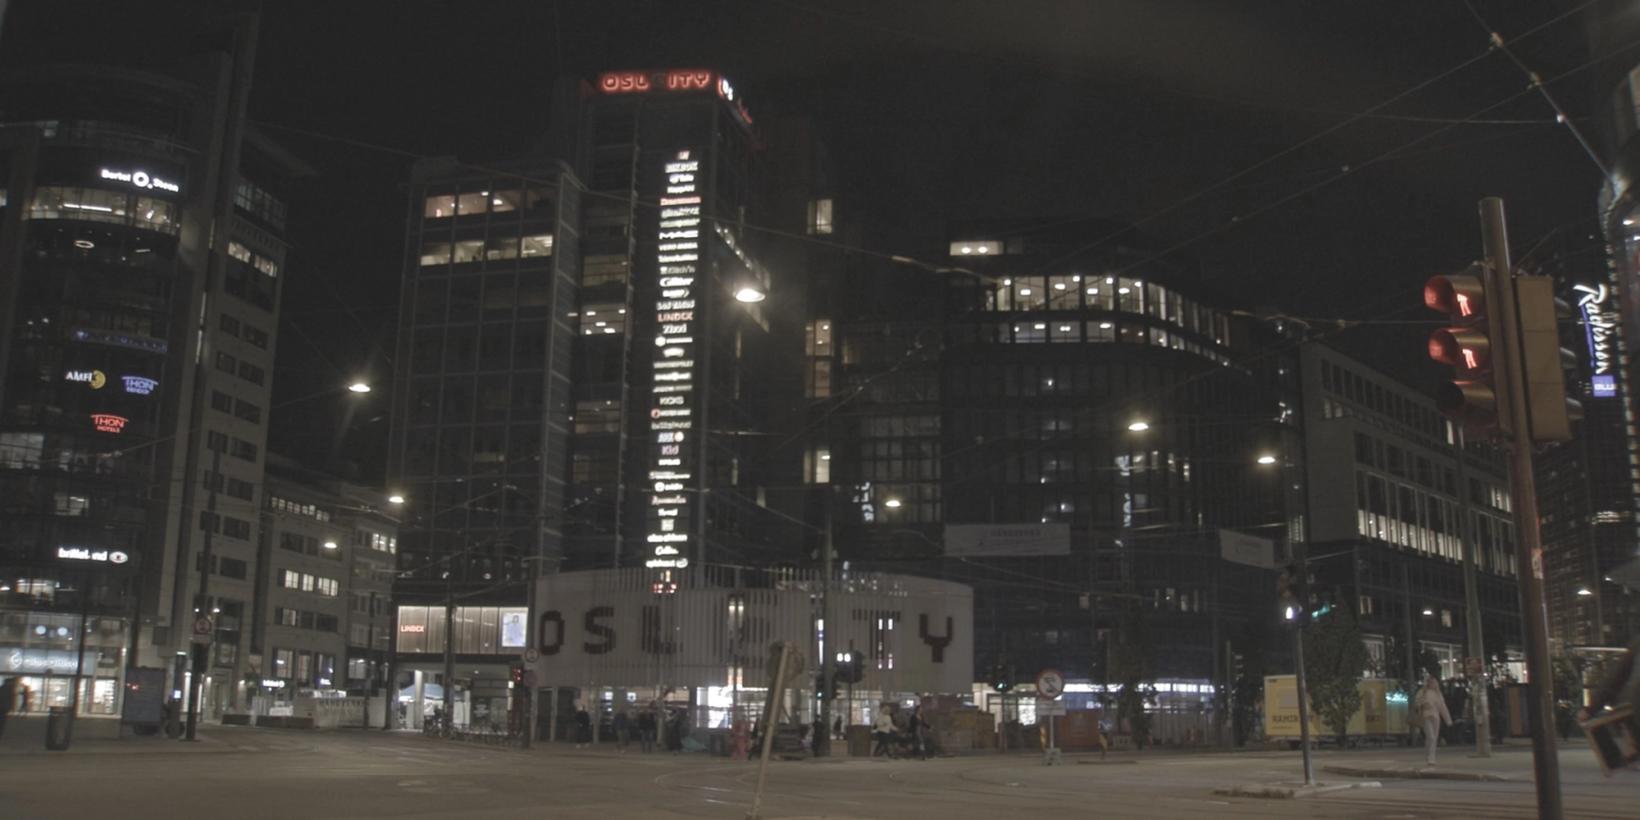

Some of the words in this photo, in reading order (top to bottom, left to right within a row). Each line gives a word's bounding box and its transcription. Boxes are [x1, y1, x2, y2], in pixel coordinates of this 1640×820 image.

[657, 311, 693, 322] LINDEX
[1572, 284, 1616, 375] Radisson
[66, 371, 94, 382] AMFI
[122, 376, 159, 391] THON
[90, 414, 129, 428] THON
[662, 445, 679, 456] Kid
[401, 625, 425, 633] LINDEX
